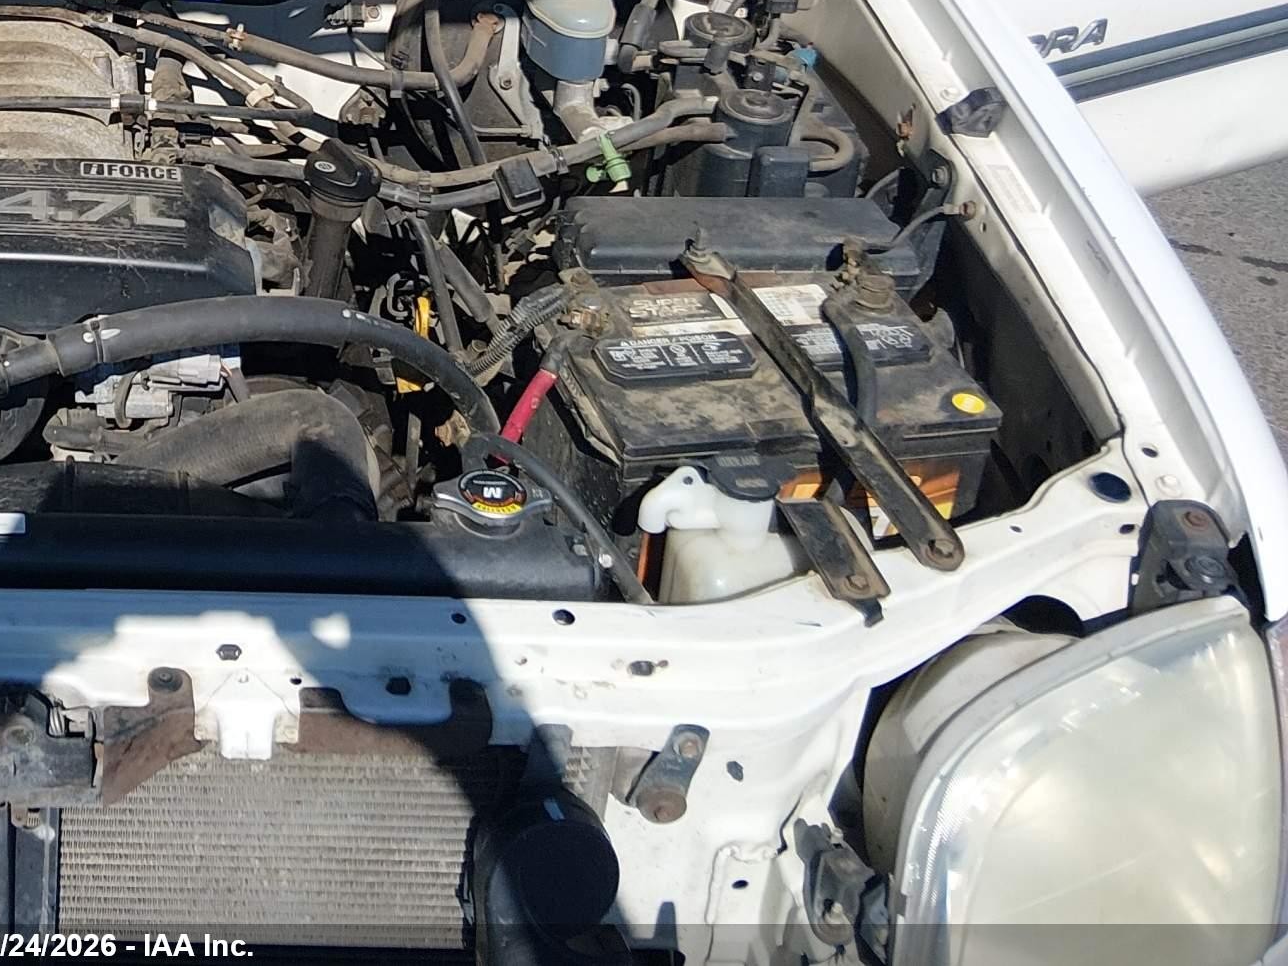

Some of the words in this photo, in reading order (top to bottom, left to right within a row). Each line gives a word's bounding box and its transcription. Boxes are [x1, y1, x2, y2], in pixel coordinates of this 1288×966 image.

[632, 297, 703, 311] SUPER
[629, 306, 711, 319] START
[630, 337, 670, 347] DANGER
